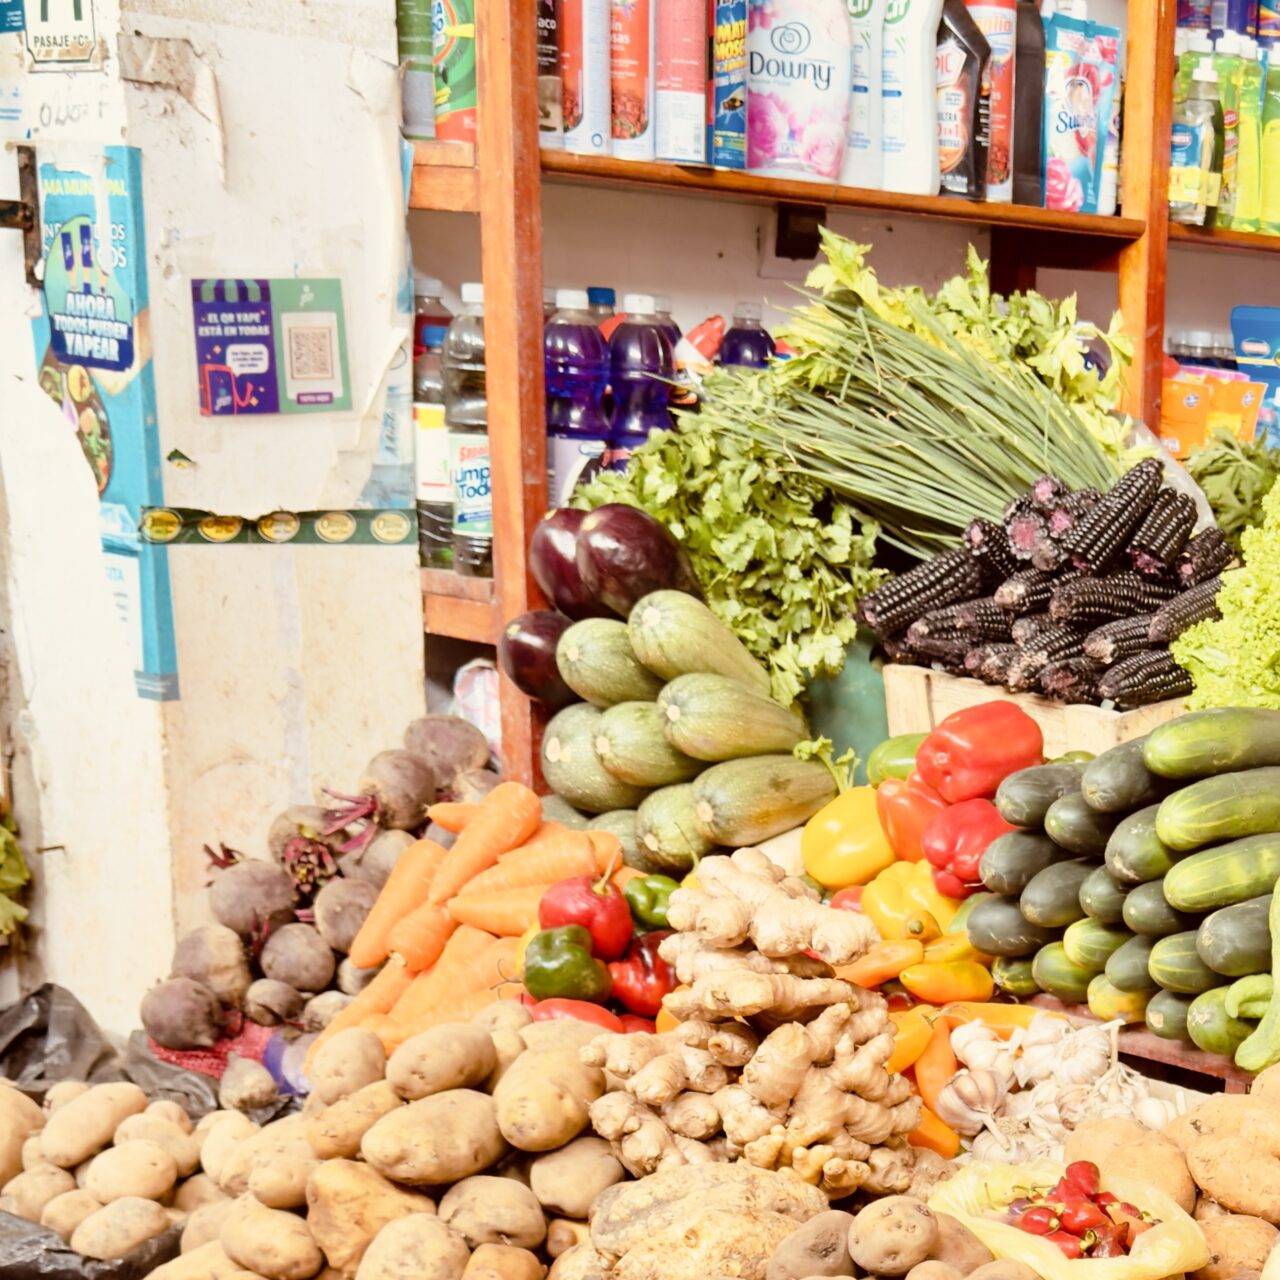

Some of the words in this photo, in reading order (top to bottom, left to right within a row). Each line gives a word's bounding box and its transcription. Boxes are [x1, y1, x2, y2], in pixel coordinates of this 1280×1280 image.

[34, 35, 69, 48] PASAJE
[750, 51, 831, 91] Downy
[65, 292, 116, 321] AHORA
[207, 313, 219, 323] EL
[236, 313, 261, 323] YAPE
[199, 324, 223, 337] ESTÁ
[224, 326, 238, 336] EN
[239, 325, 270, 336] TODAS
[64, 332, 120, 362] YAPEAR
